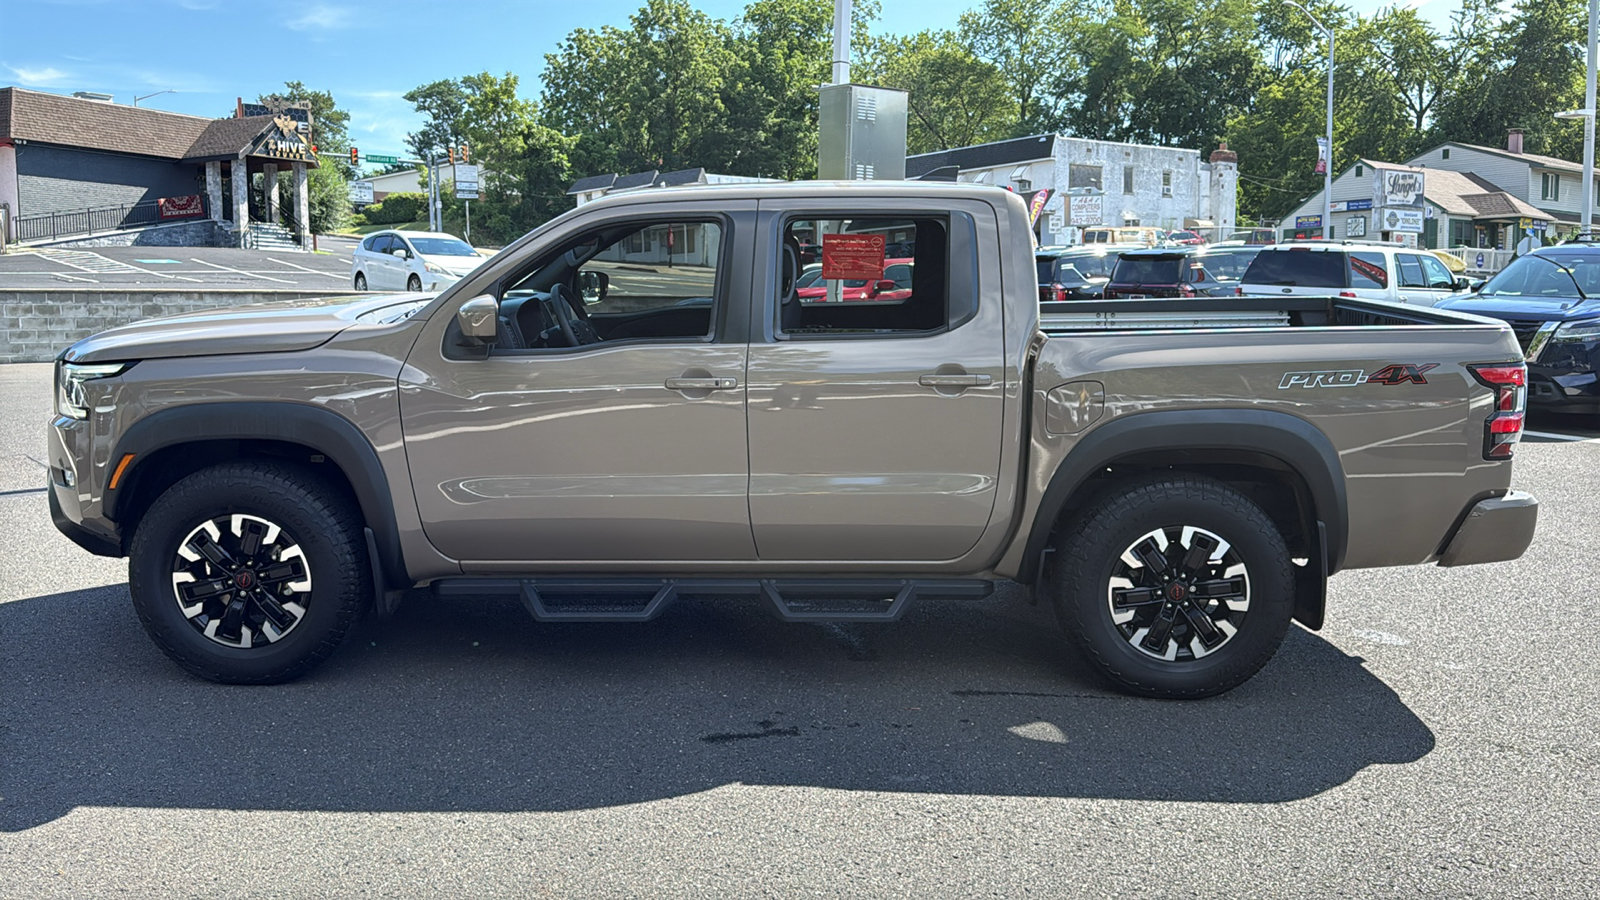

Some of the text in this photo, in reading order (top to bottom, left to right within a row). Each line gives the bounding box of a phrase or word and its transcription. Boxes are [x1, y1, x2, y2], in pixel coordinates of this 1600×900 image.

[277, 140, 306, 154] HIVE
[270, 150, 306, 160] LOUNGE
[1387, 173, 1422, 199] Langel's
[1071, 203, 1100, 211] COMPUTERS
[1071, 217, 1102, 225] 942-9700
[1278, 362, 1441, 389] PRO-4X
